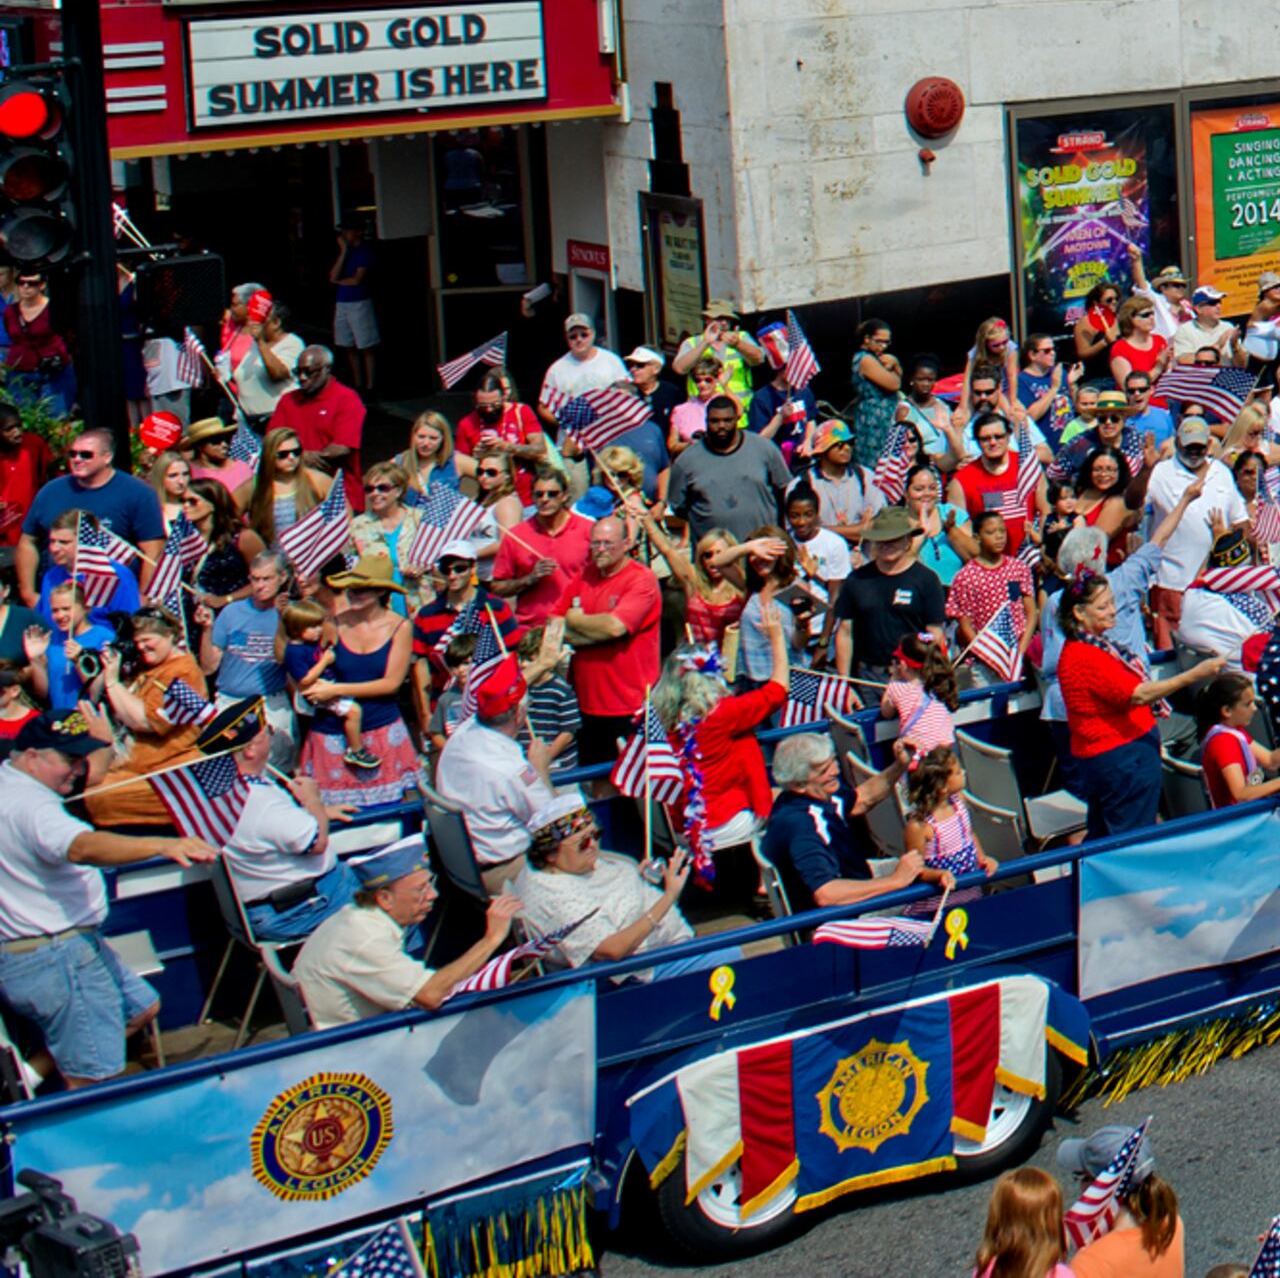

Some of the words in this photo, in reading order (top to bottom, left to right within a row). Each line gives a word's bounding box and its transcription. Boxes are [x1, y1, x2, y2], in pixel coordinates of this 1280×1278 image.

[253, 21, 370, 59] SOLID
[386, 13, 487, 49] GOLD
[207, 71, 380, 117] SUMMER
[395, 68, 435, 101] IS
[443, 58, 540, 97] HERE
[1062, 133, 1102, 148] STRAND
[1234, 138, 1280, 154] SINGING
[1026, 163, 1082, 188] SOLID
[1085, 157, 1137, 181] GOLD
[1064, 238, 1111, 255] MOTOWN
[832, 1051, 915, 1099] AMERICAN
[268, 1083, 376, 1137] AMERICAN
[842, 1111, 904, 1139] LEGION
[285, 1155, 365, 1191] LEGION
